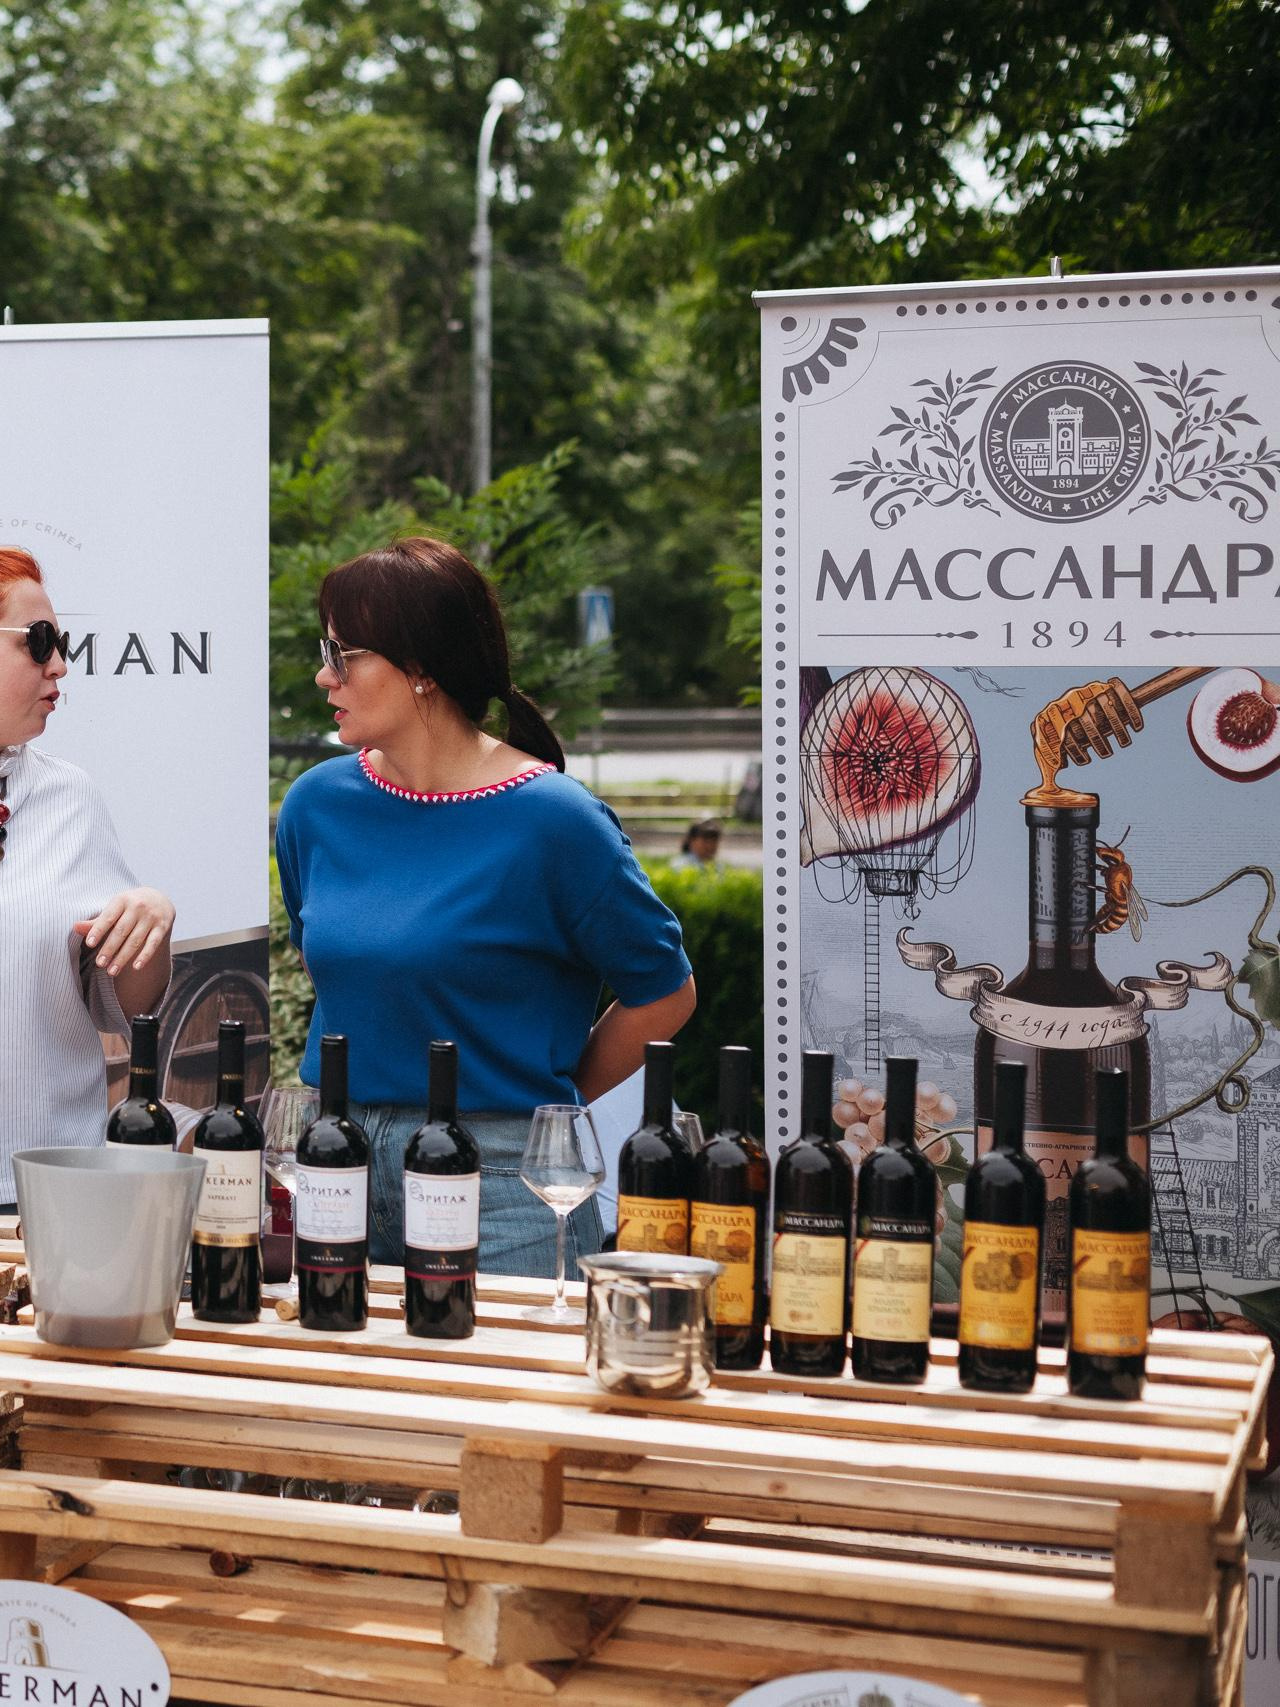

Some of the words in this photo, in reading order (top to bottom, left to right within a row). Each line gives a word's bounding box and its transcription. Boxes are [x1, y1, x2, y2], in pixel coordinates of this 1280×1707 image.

[1011, 371, 1118, 404] МАССАНДРА
[991, 428, 1053, 512] MASSANDRA
[1080, 486, 1114, 511] THE
[1114, 423, 1142, 487] CRIMEA
[1052, 478, 1080, 489] 1894
[10, 518, 29, 528] OF
[35, 521, 83, 551] CRIMEA
[816, 543, 1280, 604] МАССАНДР
[1001, 620, 1127, 648] 1894
[1016, 1016, 1070, 1040] 1944
[1080, 1017, 1124, 1048] года
[206, 1177, 252, 1186] KERMAN
[305, 1186, 352, 1196] ЭРИТАЖ
[419, 1194, 467, 1204] ЭРИТАЖ
[784, 1216, 845, 1228] МАССАНДРА
[872, 1222, 931, 1234] МАССАНДРА
